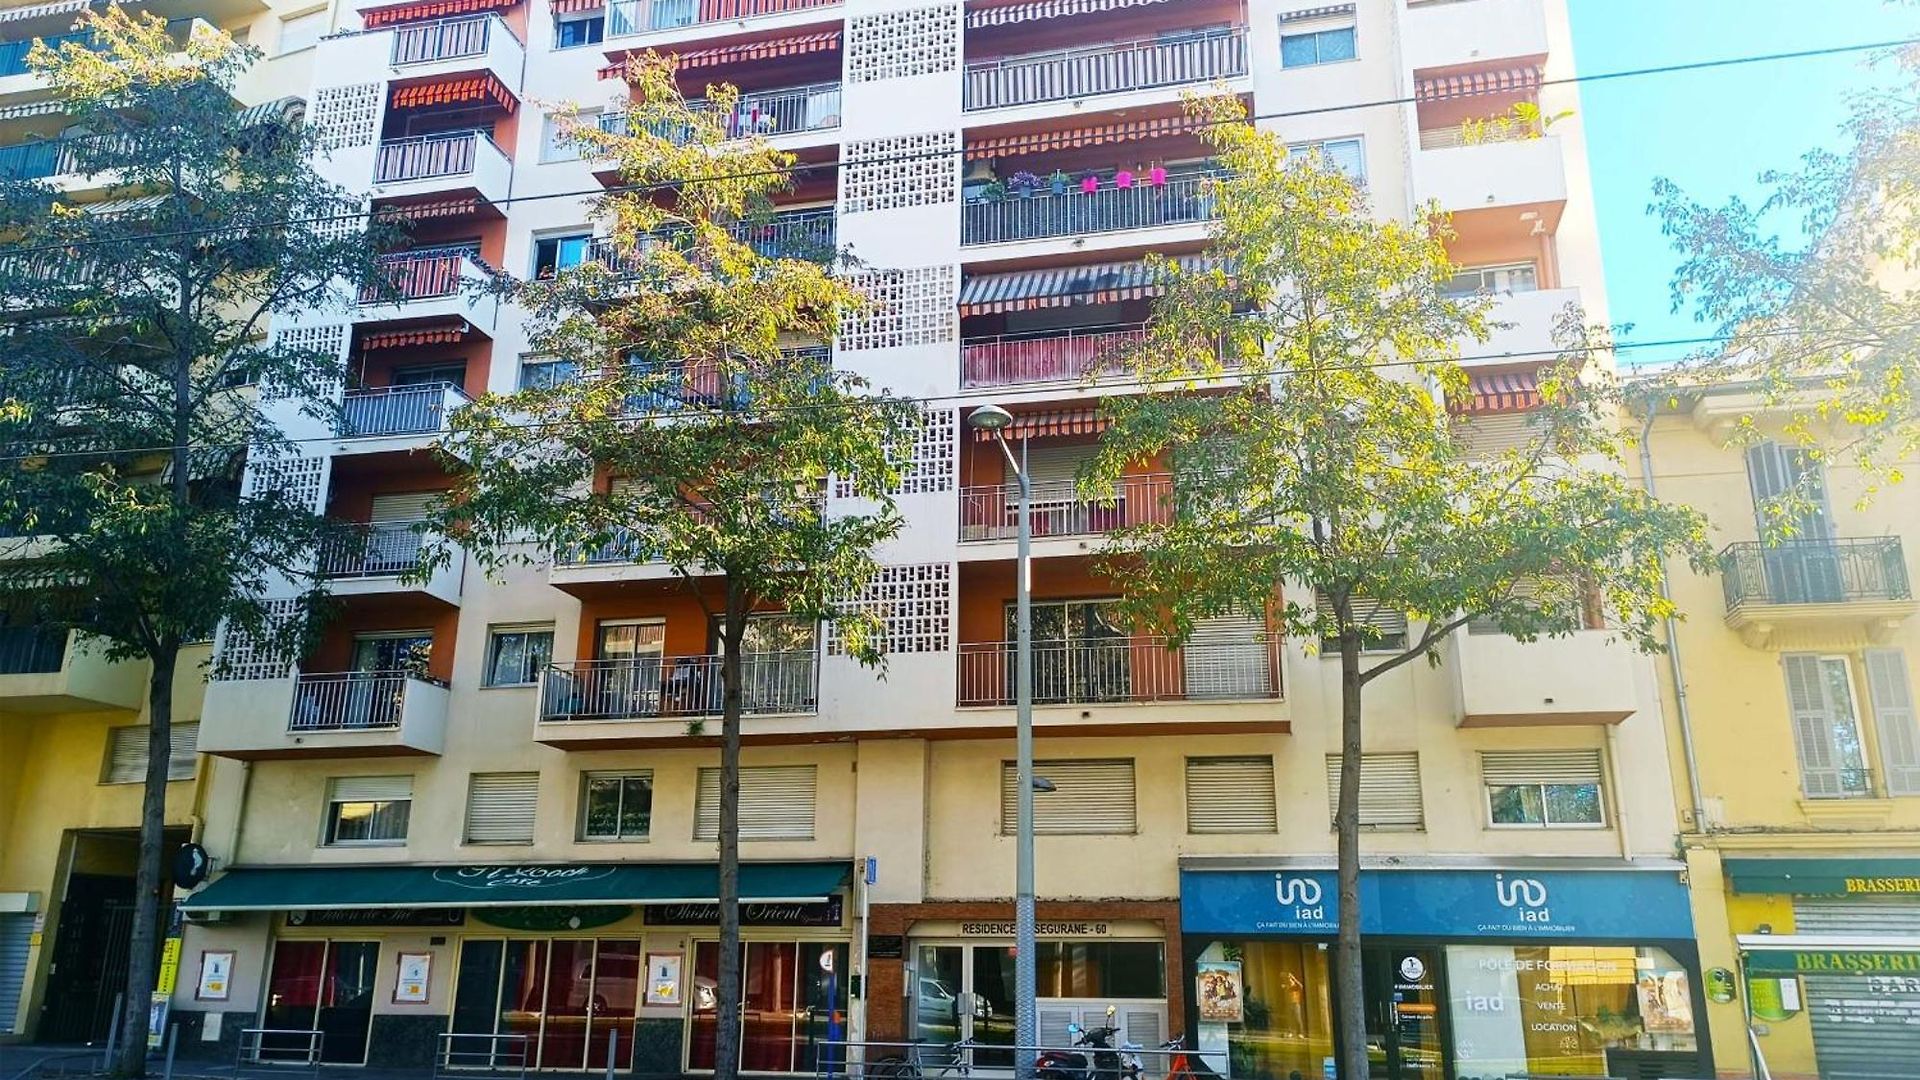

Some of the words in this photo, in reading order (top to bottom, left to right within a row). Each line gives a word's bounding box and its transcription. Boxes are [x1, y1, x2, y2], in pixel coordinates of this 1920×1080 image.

[1295, 905, 1323, 919] iad
[1519, 907, 1550, 921] iad
[962, 923, 1016, 935] RESIDENCE
[1035, 923, 1088, 934] SEGURANE
[1096, 924, 1107, 935] 60
[1516, 960, 1534, 971] DE
[1796, 952, 1920, 970] BRASSERI
[1466, 990, 1504, 1011] iad
[1537, 1002, 1567, 1011] VENTE
[1531, 1023, 1577, 1032] LOCATION
